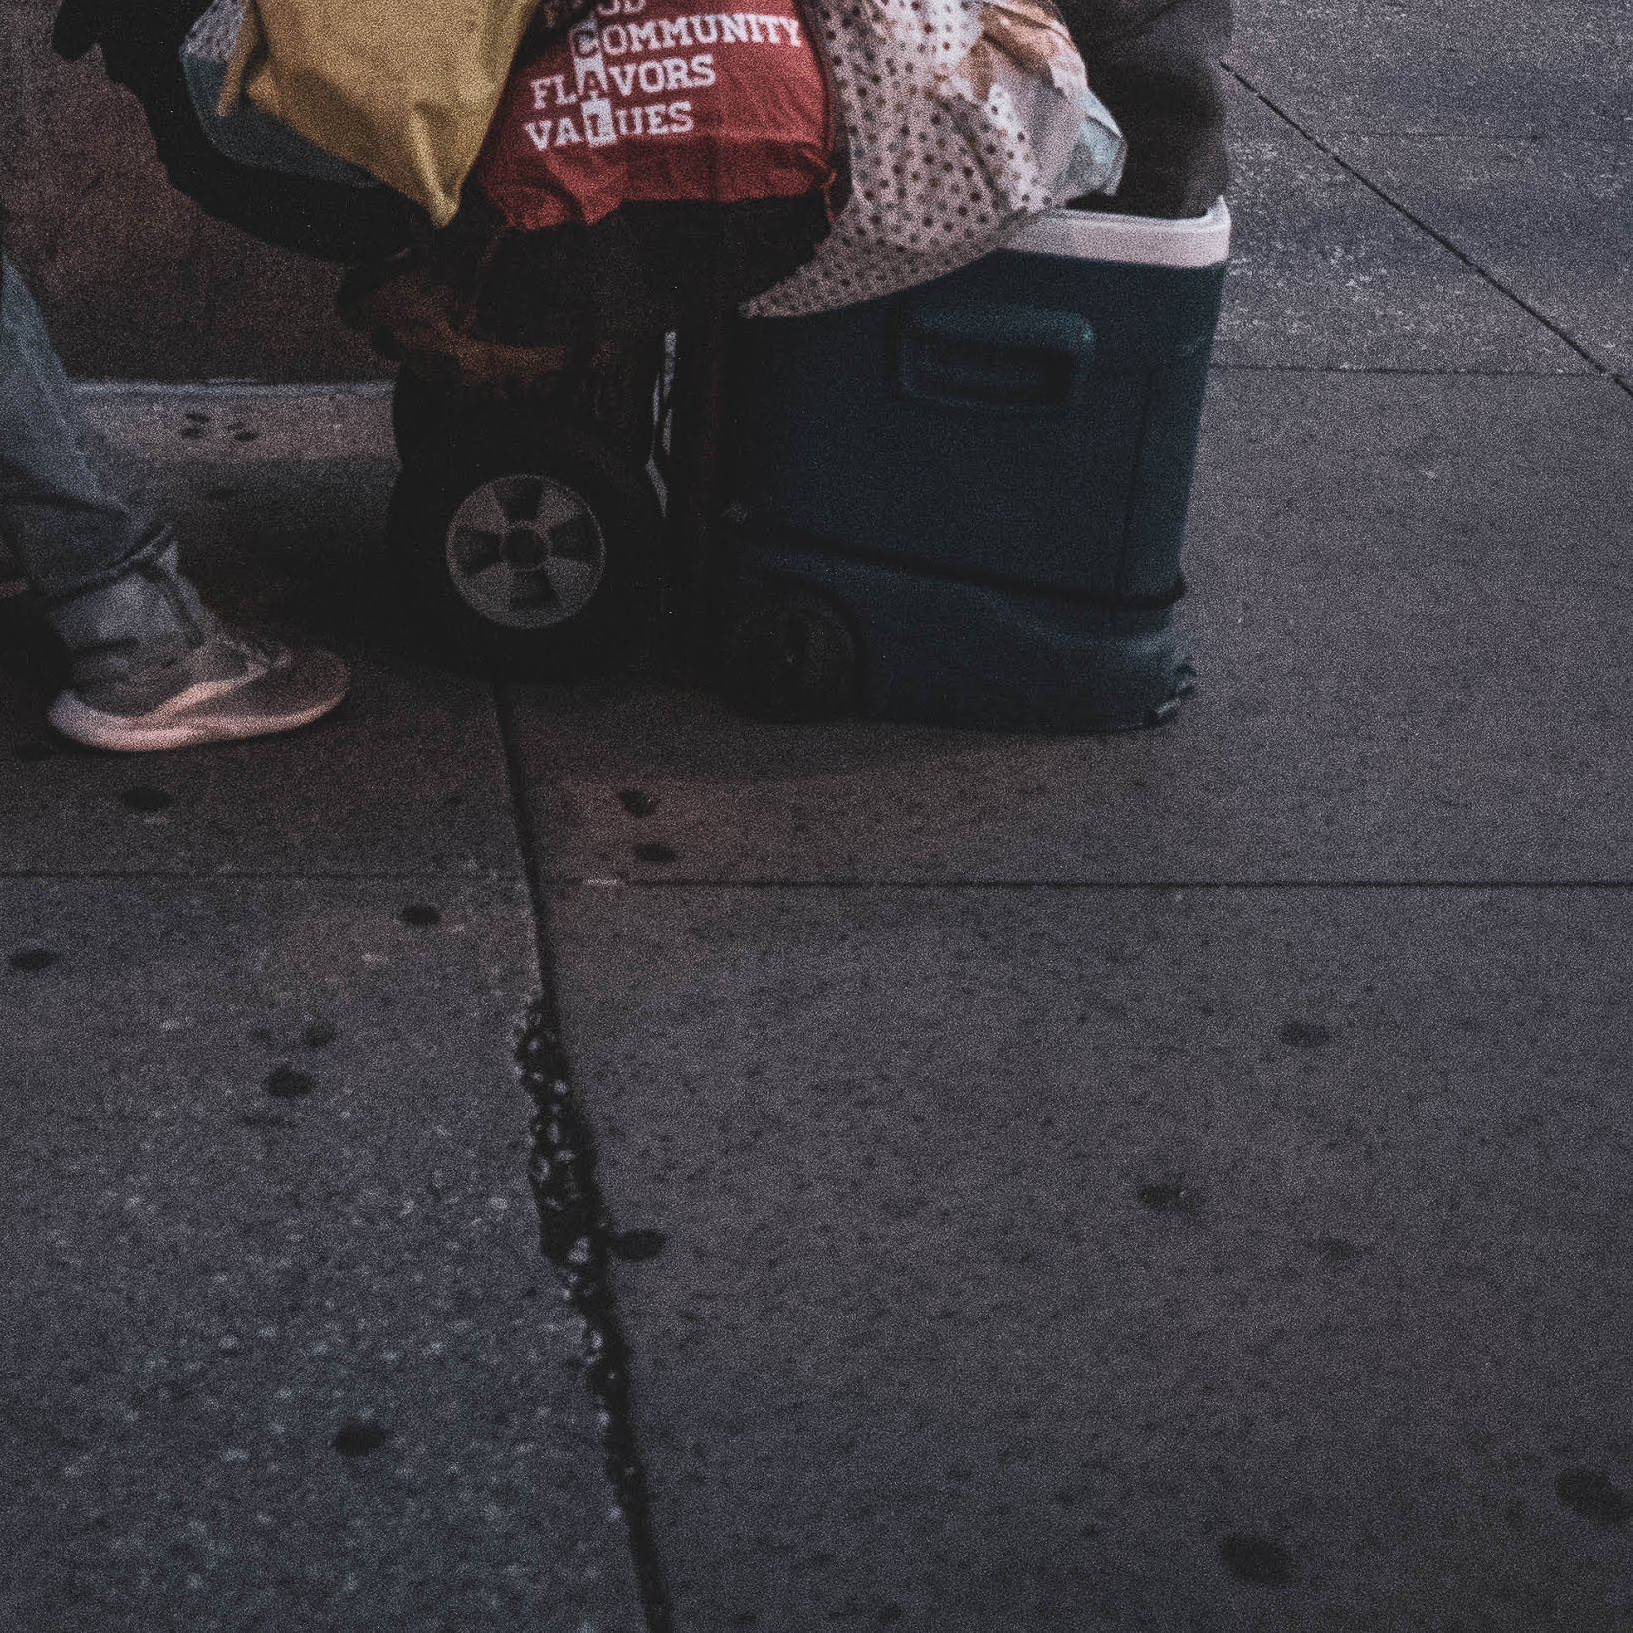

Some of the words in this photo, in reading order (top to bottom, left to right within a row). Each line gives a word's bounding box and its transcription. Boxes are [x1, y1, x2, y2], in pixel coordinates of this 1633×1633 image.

[569, 11, 804, 59] COMMUNITY
[529, 54, 717, 110] FLAVORS
[523, 100, 696, 152] VALUES
